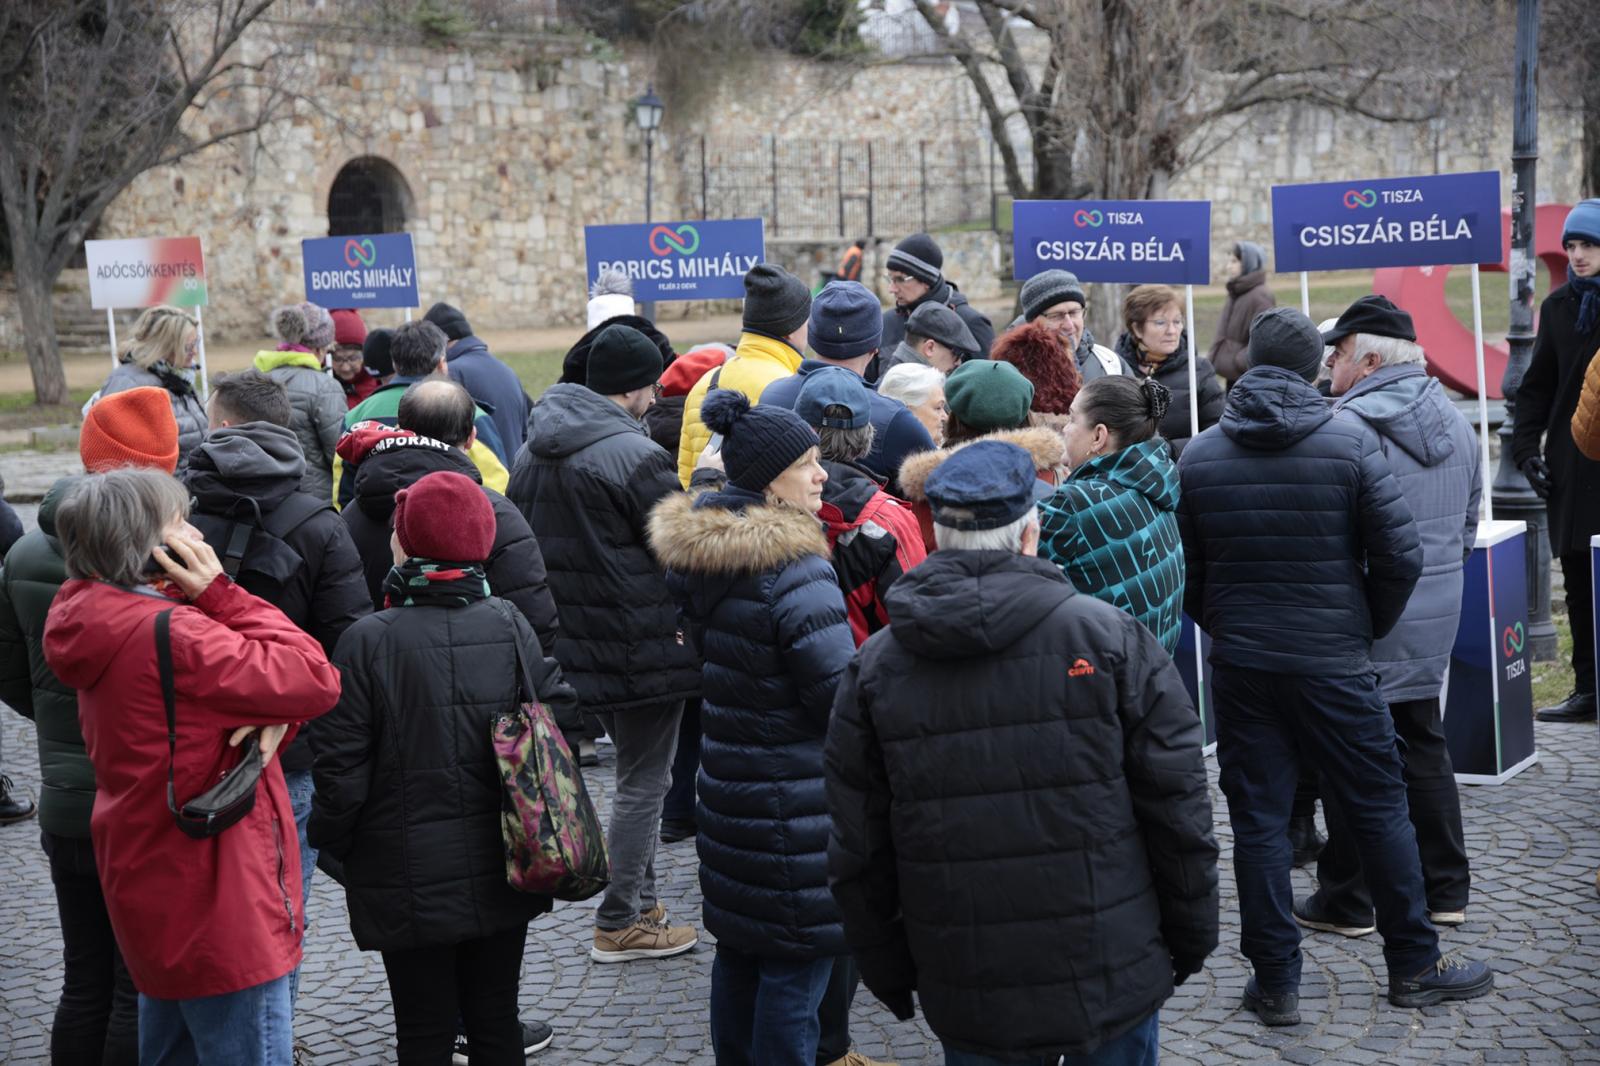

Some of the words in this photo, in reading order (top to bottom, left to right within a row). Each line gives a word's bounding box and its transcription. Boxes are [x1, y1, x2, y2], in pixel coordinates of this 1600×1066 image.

[1381, 189, 1424, 204] TISZA
[1107, 212, 1144, 225] TISZA
[1300, 217, 1404, 248] CSISZÁR
[1410, 214, 1473, 242] BÉLA
[1036, 236, 1126, 261] CSISZÁR
[1131, 236, 1185, 262] BÉLA
[97, 259, 196, 278] ADÓCSÖKKENTÉS
[311, 270, 362, 291] BORICS
[363, 264, 413, 289] MIHÁLY
[678, 252, 759, 278] MIHÁLY
[1505, 657, 1526, 681] TISZA
